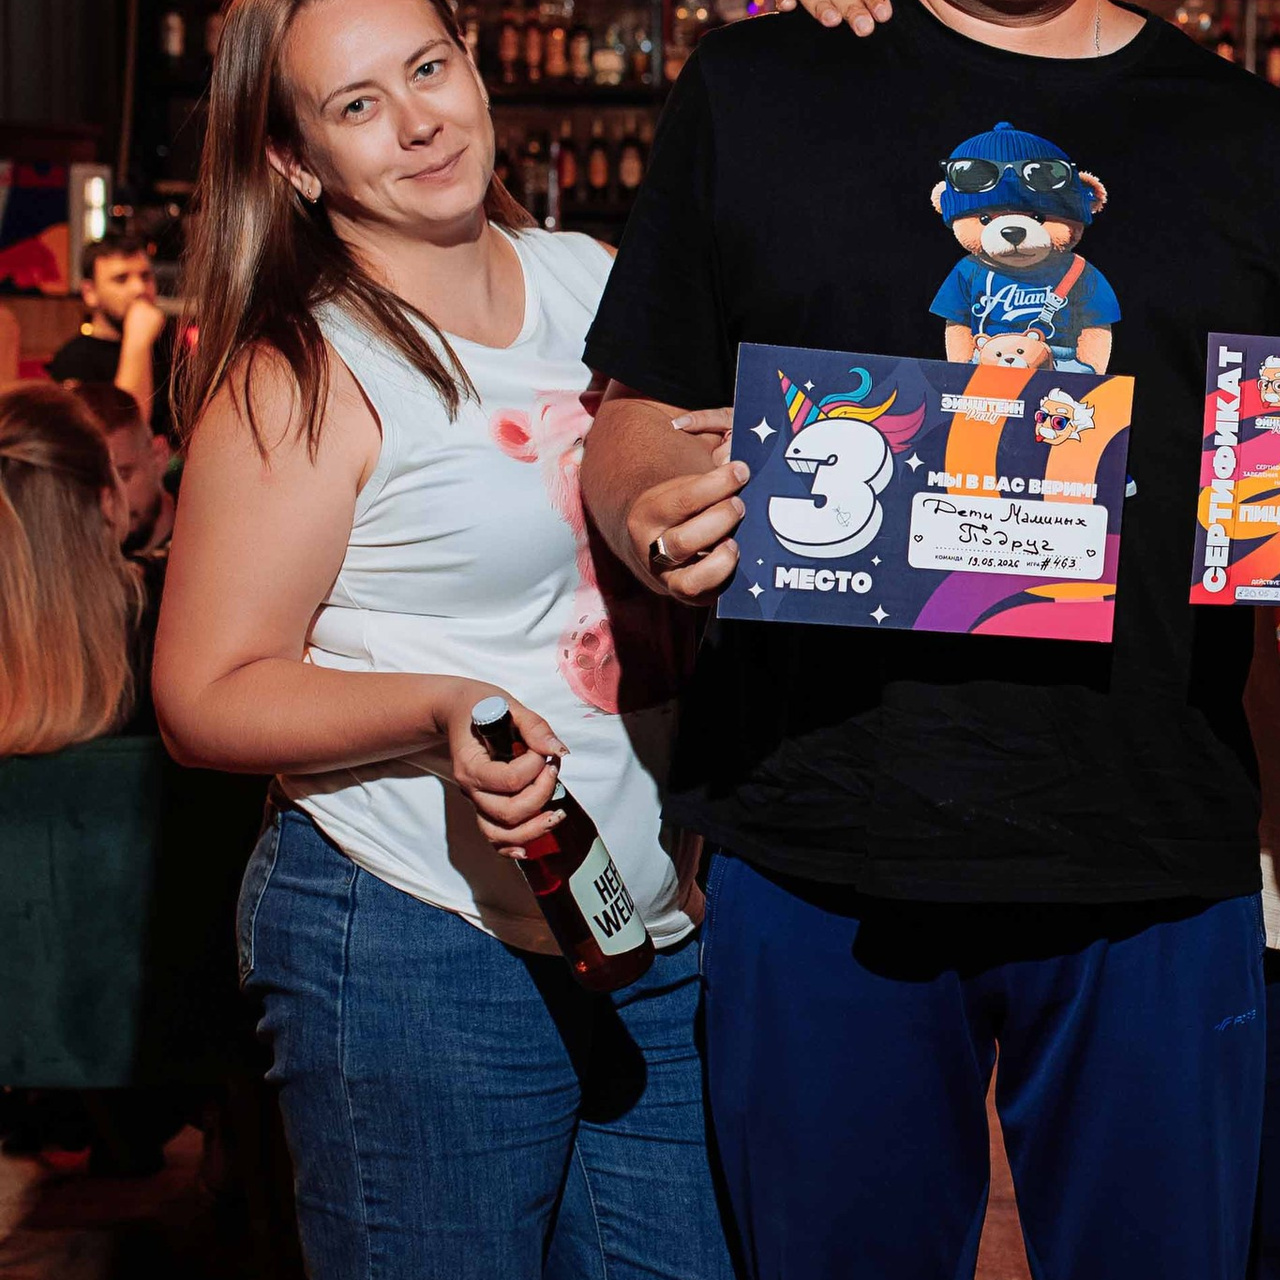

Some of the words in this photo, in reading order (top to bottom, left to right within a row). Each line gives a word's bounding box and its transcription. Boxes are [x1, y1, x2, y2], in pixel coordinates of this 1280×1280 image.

[965, 407, 1000, 425] Party
[1203, 346, 1243, 594] СЕРТИФИКАТ
[768, 419, 894, 559] 3
[927, 471, 962, 489] МЫ
[965, 474, 979, 489] В
[982, 475, 1025, 493] ВАС
[1028, 479, 1098, 499] ВЕРИМ!
[922, 498, 993, 521] Дети
[935, 554, 963, 562] КОМАНДА
[968, 556, 1020, 568] 19.05.2026
[775, 567, 873, 594] МЕСТО
